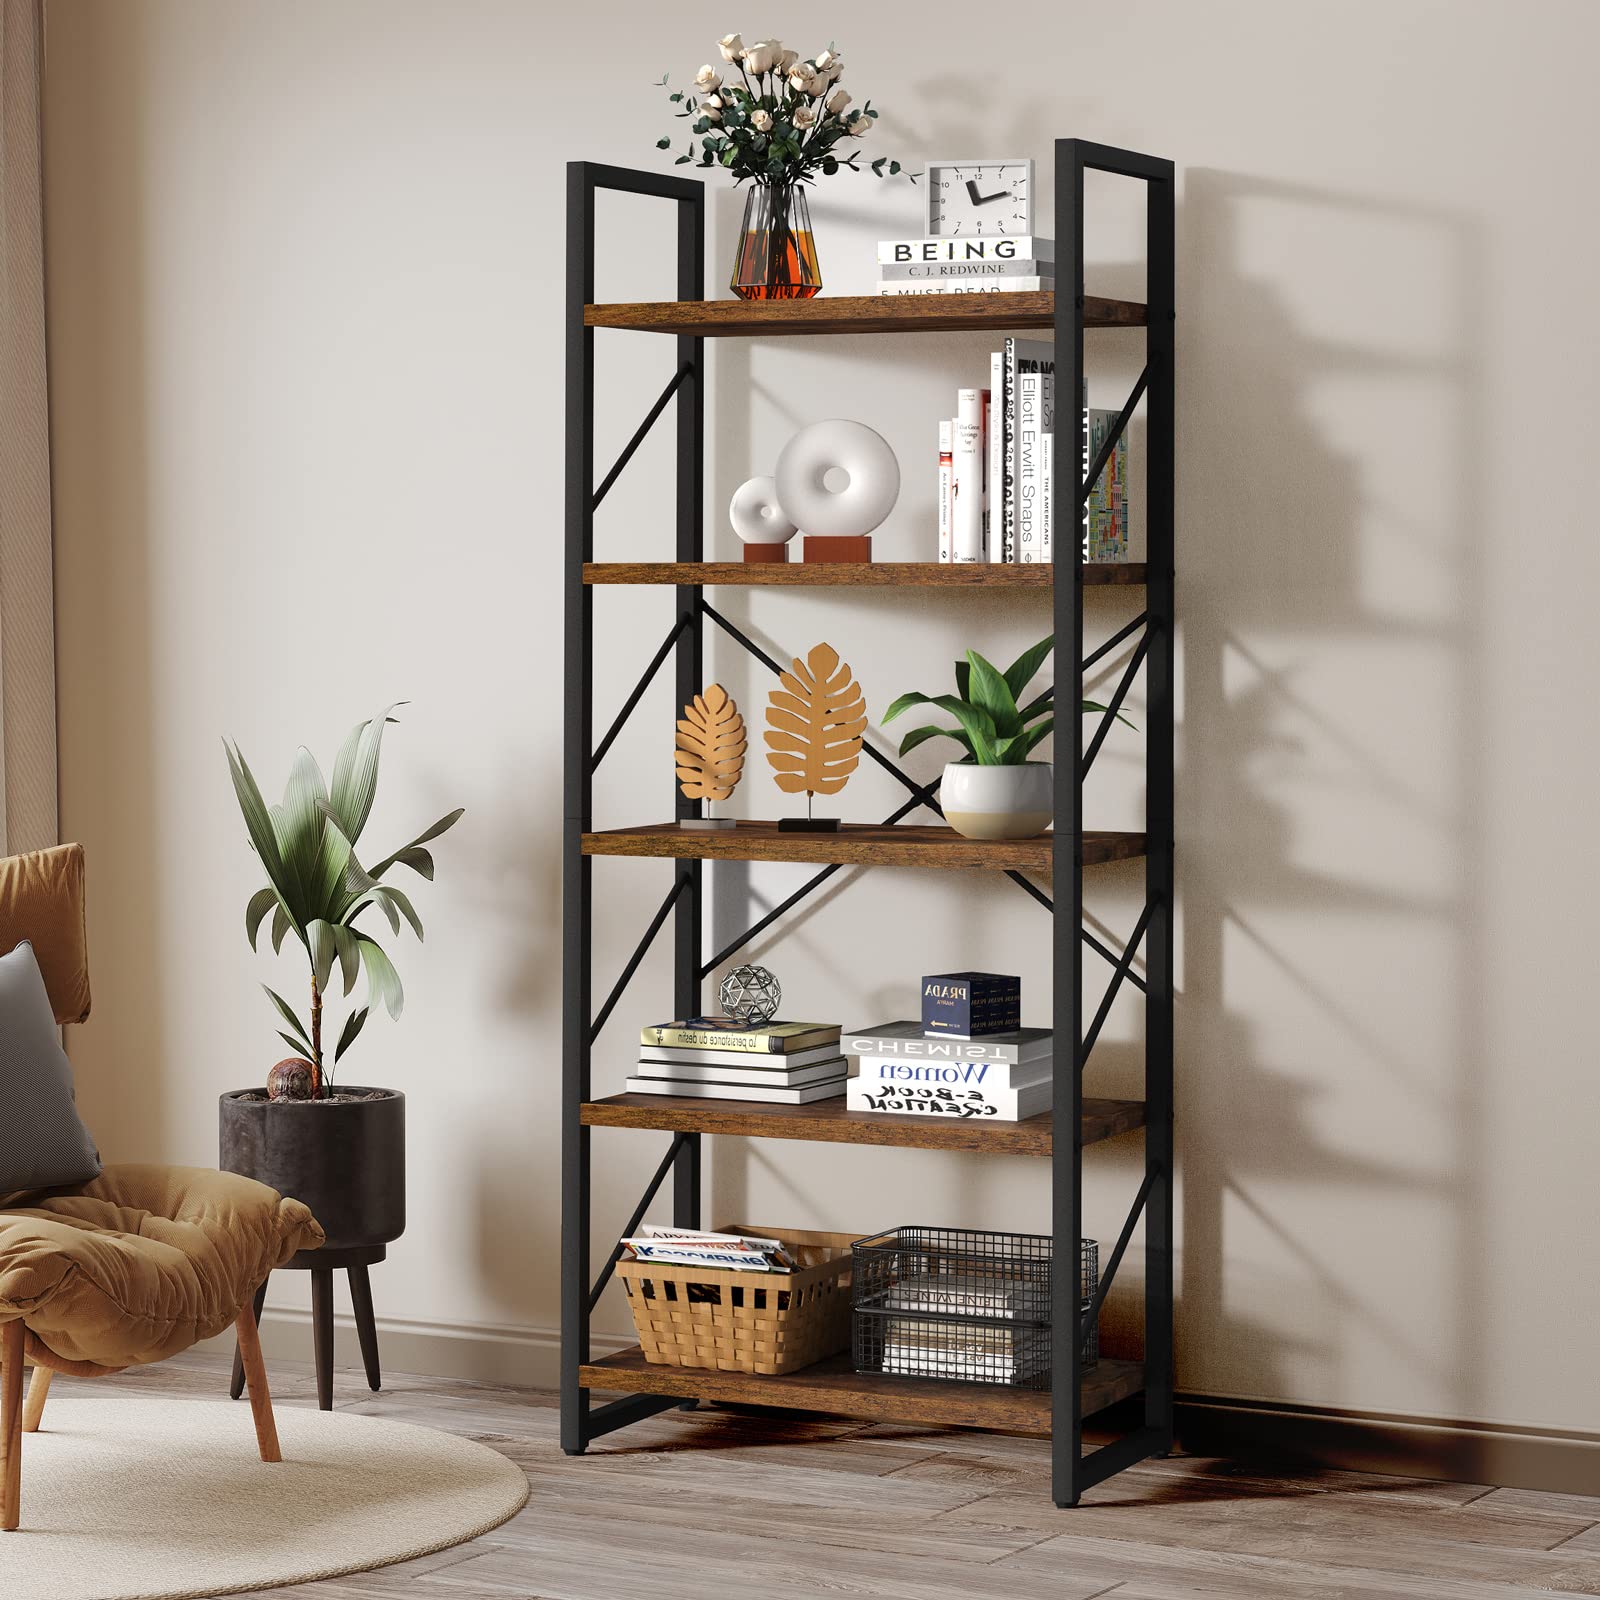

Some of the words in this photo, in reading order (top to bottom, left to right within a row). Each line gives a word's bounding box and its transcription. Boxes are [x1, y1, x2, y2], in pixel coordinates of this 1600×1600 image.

[895, 240, 1015, 262] BEING
[909, 266, 921, 276] C.
[926, 266, 934, 276] J.
[940, 264, 1005, 275] REDWINE
[1022, 378, 1036, 424] Elliott
[1022, 430, 1036, 479] Erwitt
[1020, 485, 1036, 542] Snaps
